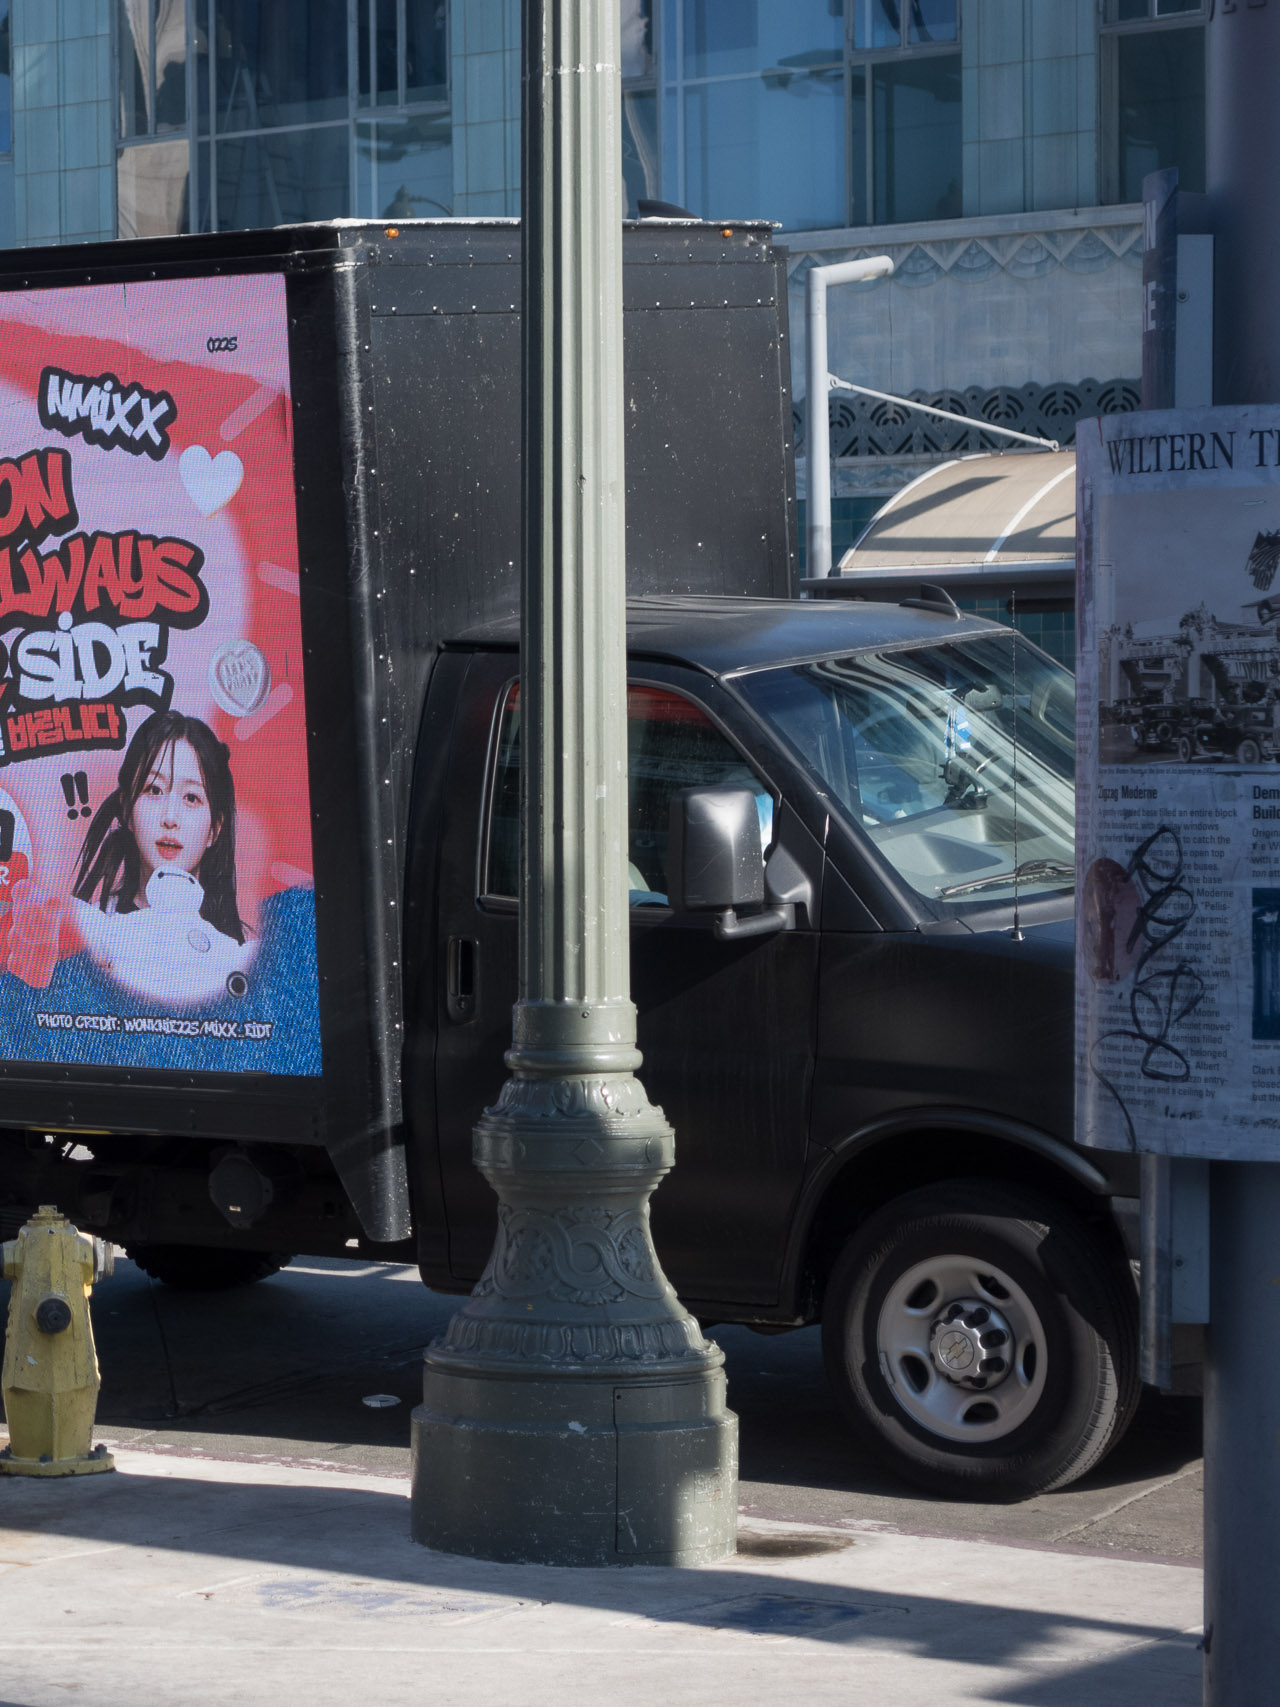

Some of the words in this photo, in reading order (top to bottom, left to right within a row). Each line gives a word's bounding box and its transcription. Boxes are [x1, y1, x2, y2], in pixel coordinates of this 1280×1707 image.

[1107, 430, 1237, 476] WILTERN
[1098, 784, 1119, 802] Zigzag
[1122, 785, 1158, 799] Moderne
[1160, 808, 1177, 818] filled
[1178, 810, 1188, 818] an
[1189, 809, 1213, 818] entire
[1214, 808, 1238, 819] block
[1183, 822, 1220, 831] windows
[1183, 836, 1191, 844] to
[1192, 835, 1215, 845] catch
[1217, 835, 1231, 845] the
[1189, 850, 1209, 859] open
[1211, 849, 1225, 859] top
[1187, 875, 1201, 884] the
[1202, 875, 1223, 885] base
[1196, 887, 1234, 898] Moderne
[1195, 915, 1229, 925] ceramic
[1209, 928, 1233, 938] chev-
[1184, 942, 1212, 952] angled
[1212, 955, 1232, 965] Just
[1196, 967, 1209, 977] but
[1211, 968, 1230, 978] with
[1202, 995, 1216, 1004] the
[1193, 1007, 1220, 1017] Moore
[36, 1013, 73, 1028] PHOTO
[1202, 1034, 1223, 1044] filled
[1190, 1048, 1228, 1059] belonged
[1195, 1061, 1220, 1071] Albert
[1252, 1064, 1275, 1075] Clark
[1204, 1077, 1229, 1087] entry-
[1178, 1088, 1204, 1099] ceiling
[1205, 1089, 1216, 1099] by
[1252, 1092, 1267, 1102] but
